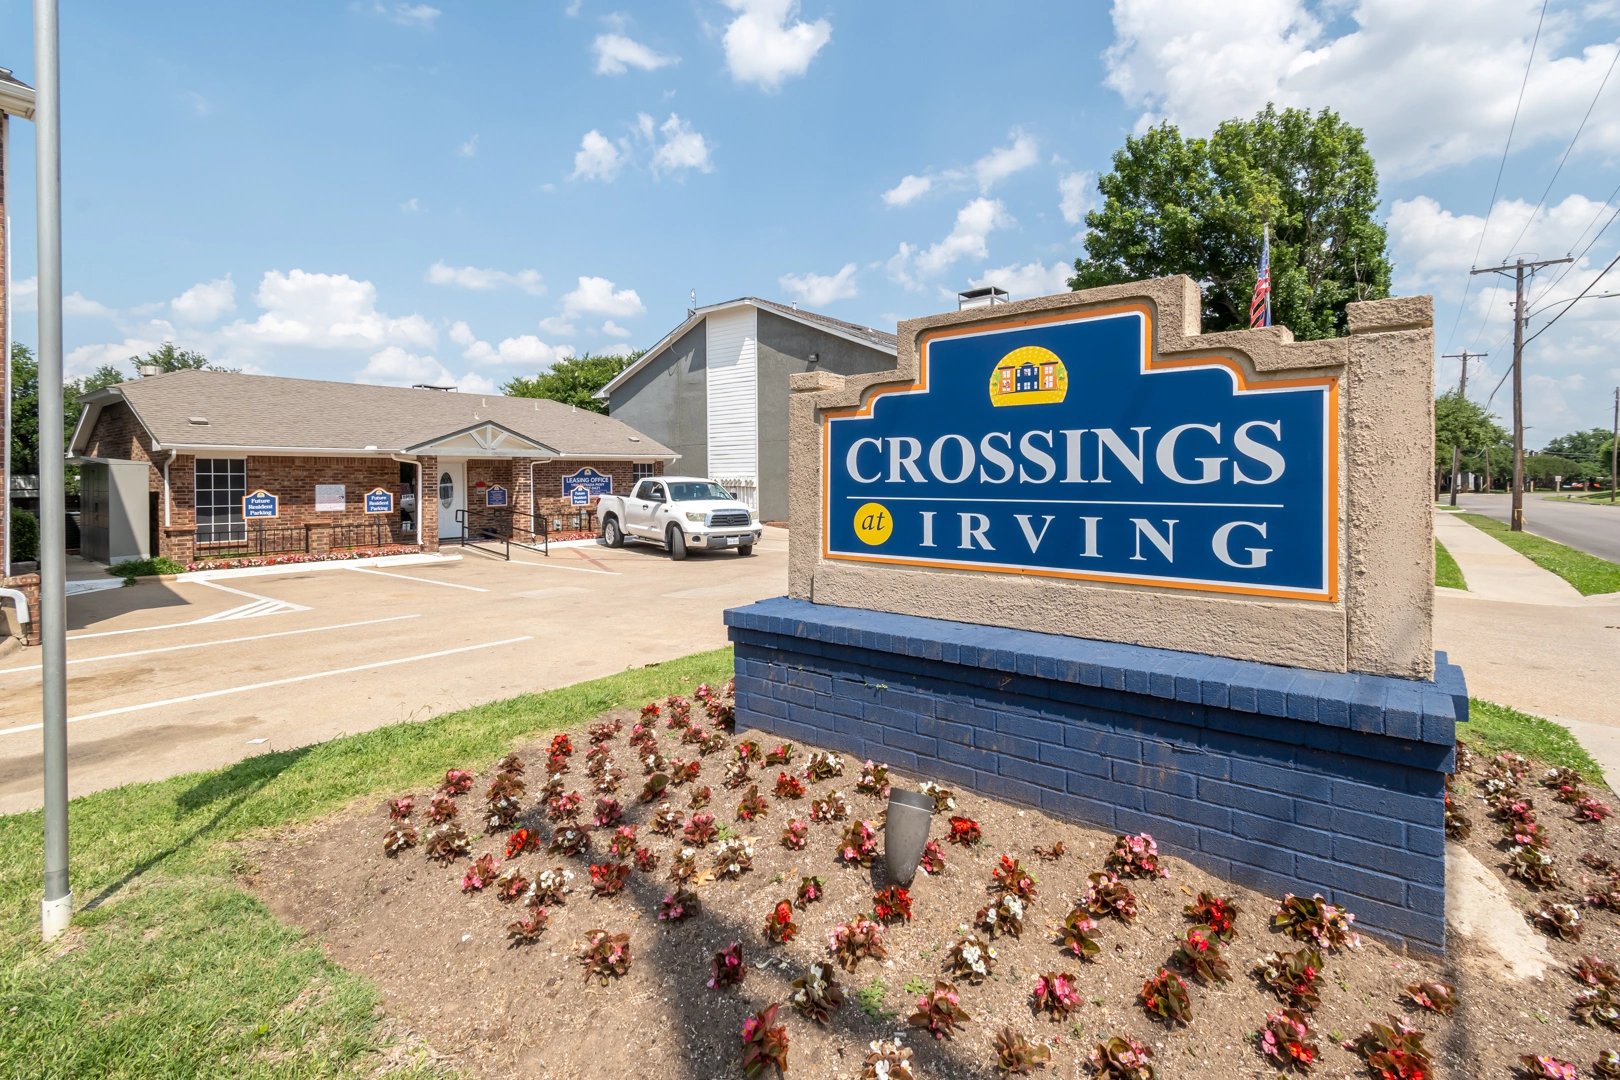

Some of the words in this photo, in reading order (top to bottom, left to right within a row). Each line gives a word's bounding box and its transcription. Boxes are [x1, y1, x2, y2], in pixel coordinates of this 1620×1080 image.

[846, 420, 1286, 485] CROSSINGS
[862, 512, 884, 530] at
[919, 511, 1273, 569] IRVING
